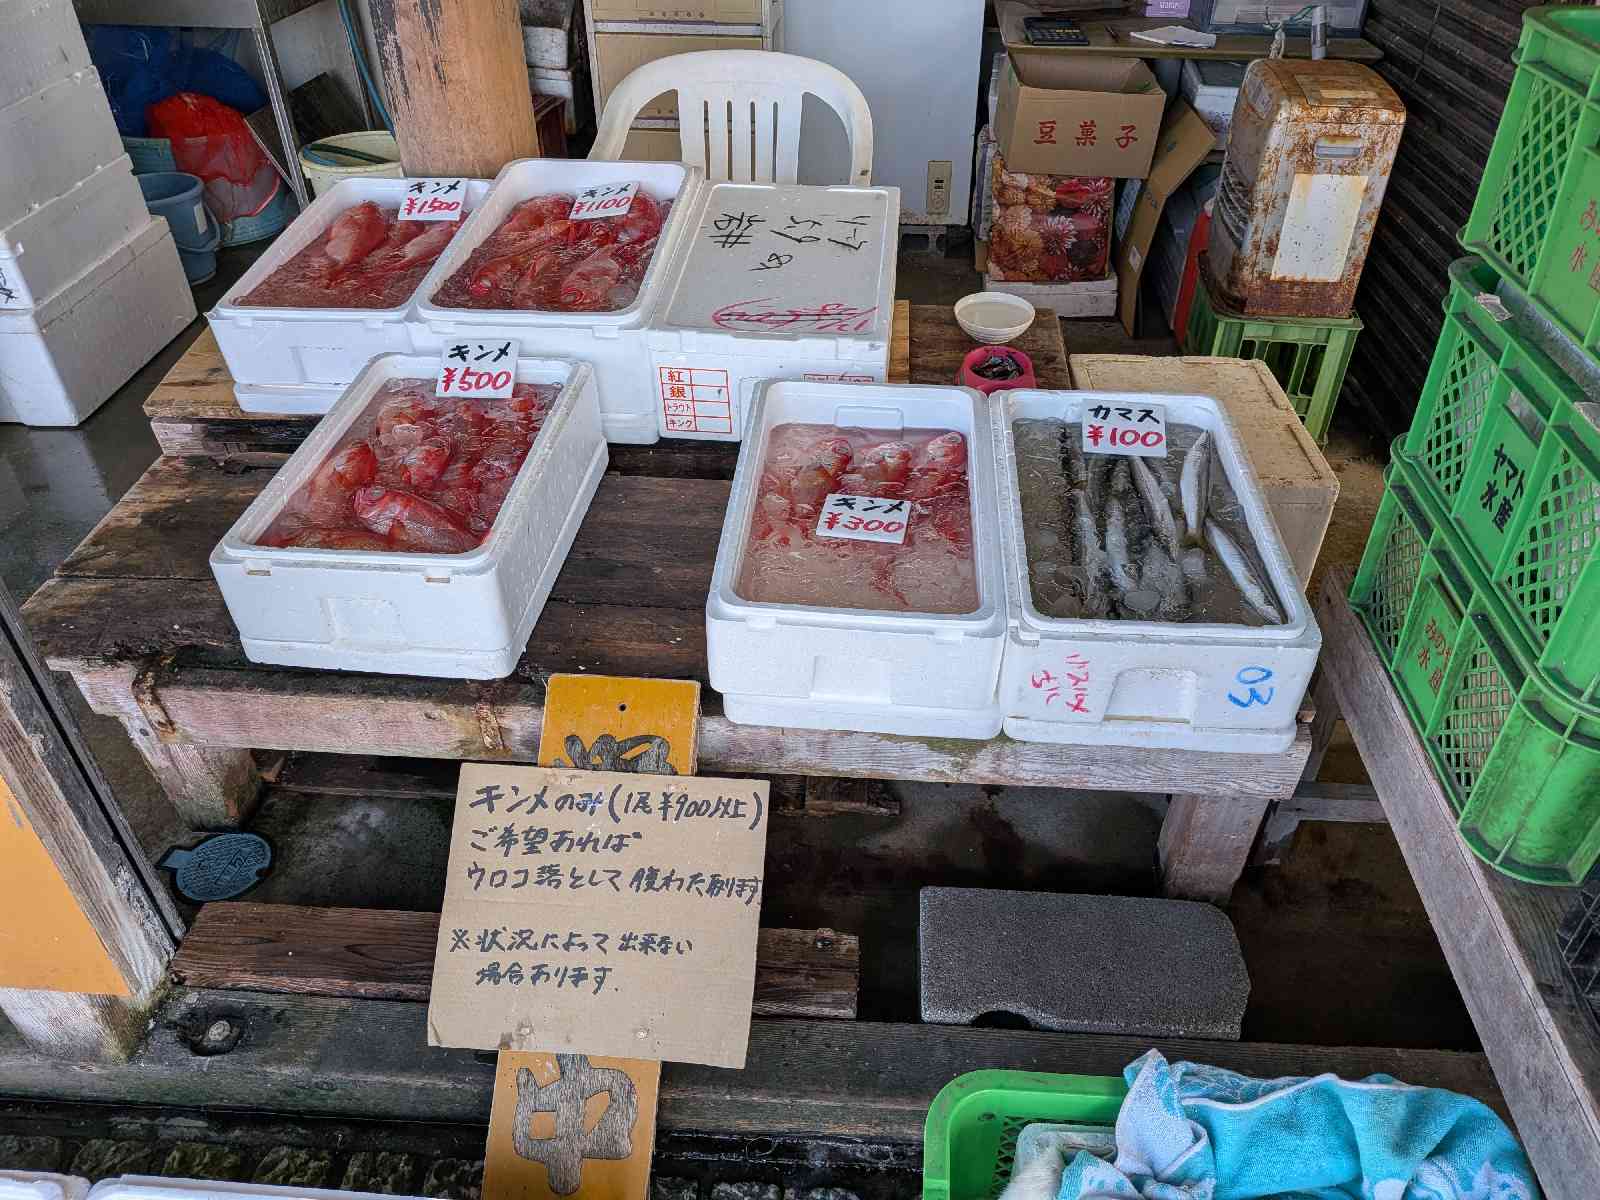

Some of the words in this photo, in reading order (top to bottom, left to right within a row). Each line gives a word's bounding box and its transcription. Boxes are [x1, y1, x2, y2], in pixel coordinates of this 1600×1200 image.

[1033, 120, 1138, 150] 豆菓子
[408, 181, 461, 195] キンメ
[581, 183, 632, 199] キンメ
[447, 341, 512, 363] キンメ
[442, 366, 512, 393] ¥500
[667, 369, 684, 383] 紅
[670, 385, 687, 399] 銀
[668, 402, 691, 414] トラウト
[1087, 404, 1161, 424] カマス
[1087, 425, 1164, 449] ¥100
[1492, 442, 1526, 501] ヤマト
[832, 497, 905, 514] キンメ
[1479, 480, 1514, 534] 水産
[822, 511, 905, 534] ¥300
[470, 823, 642, 857] ご希望あれば
[513, 1053, 638, 1196] 中
